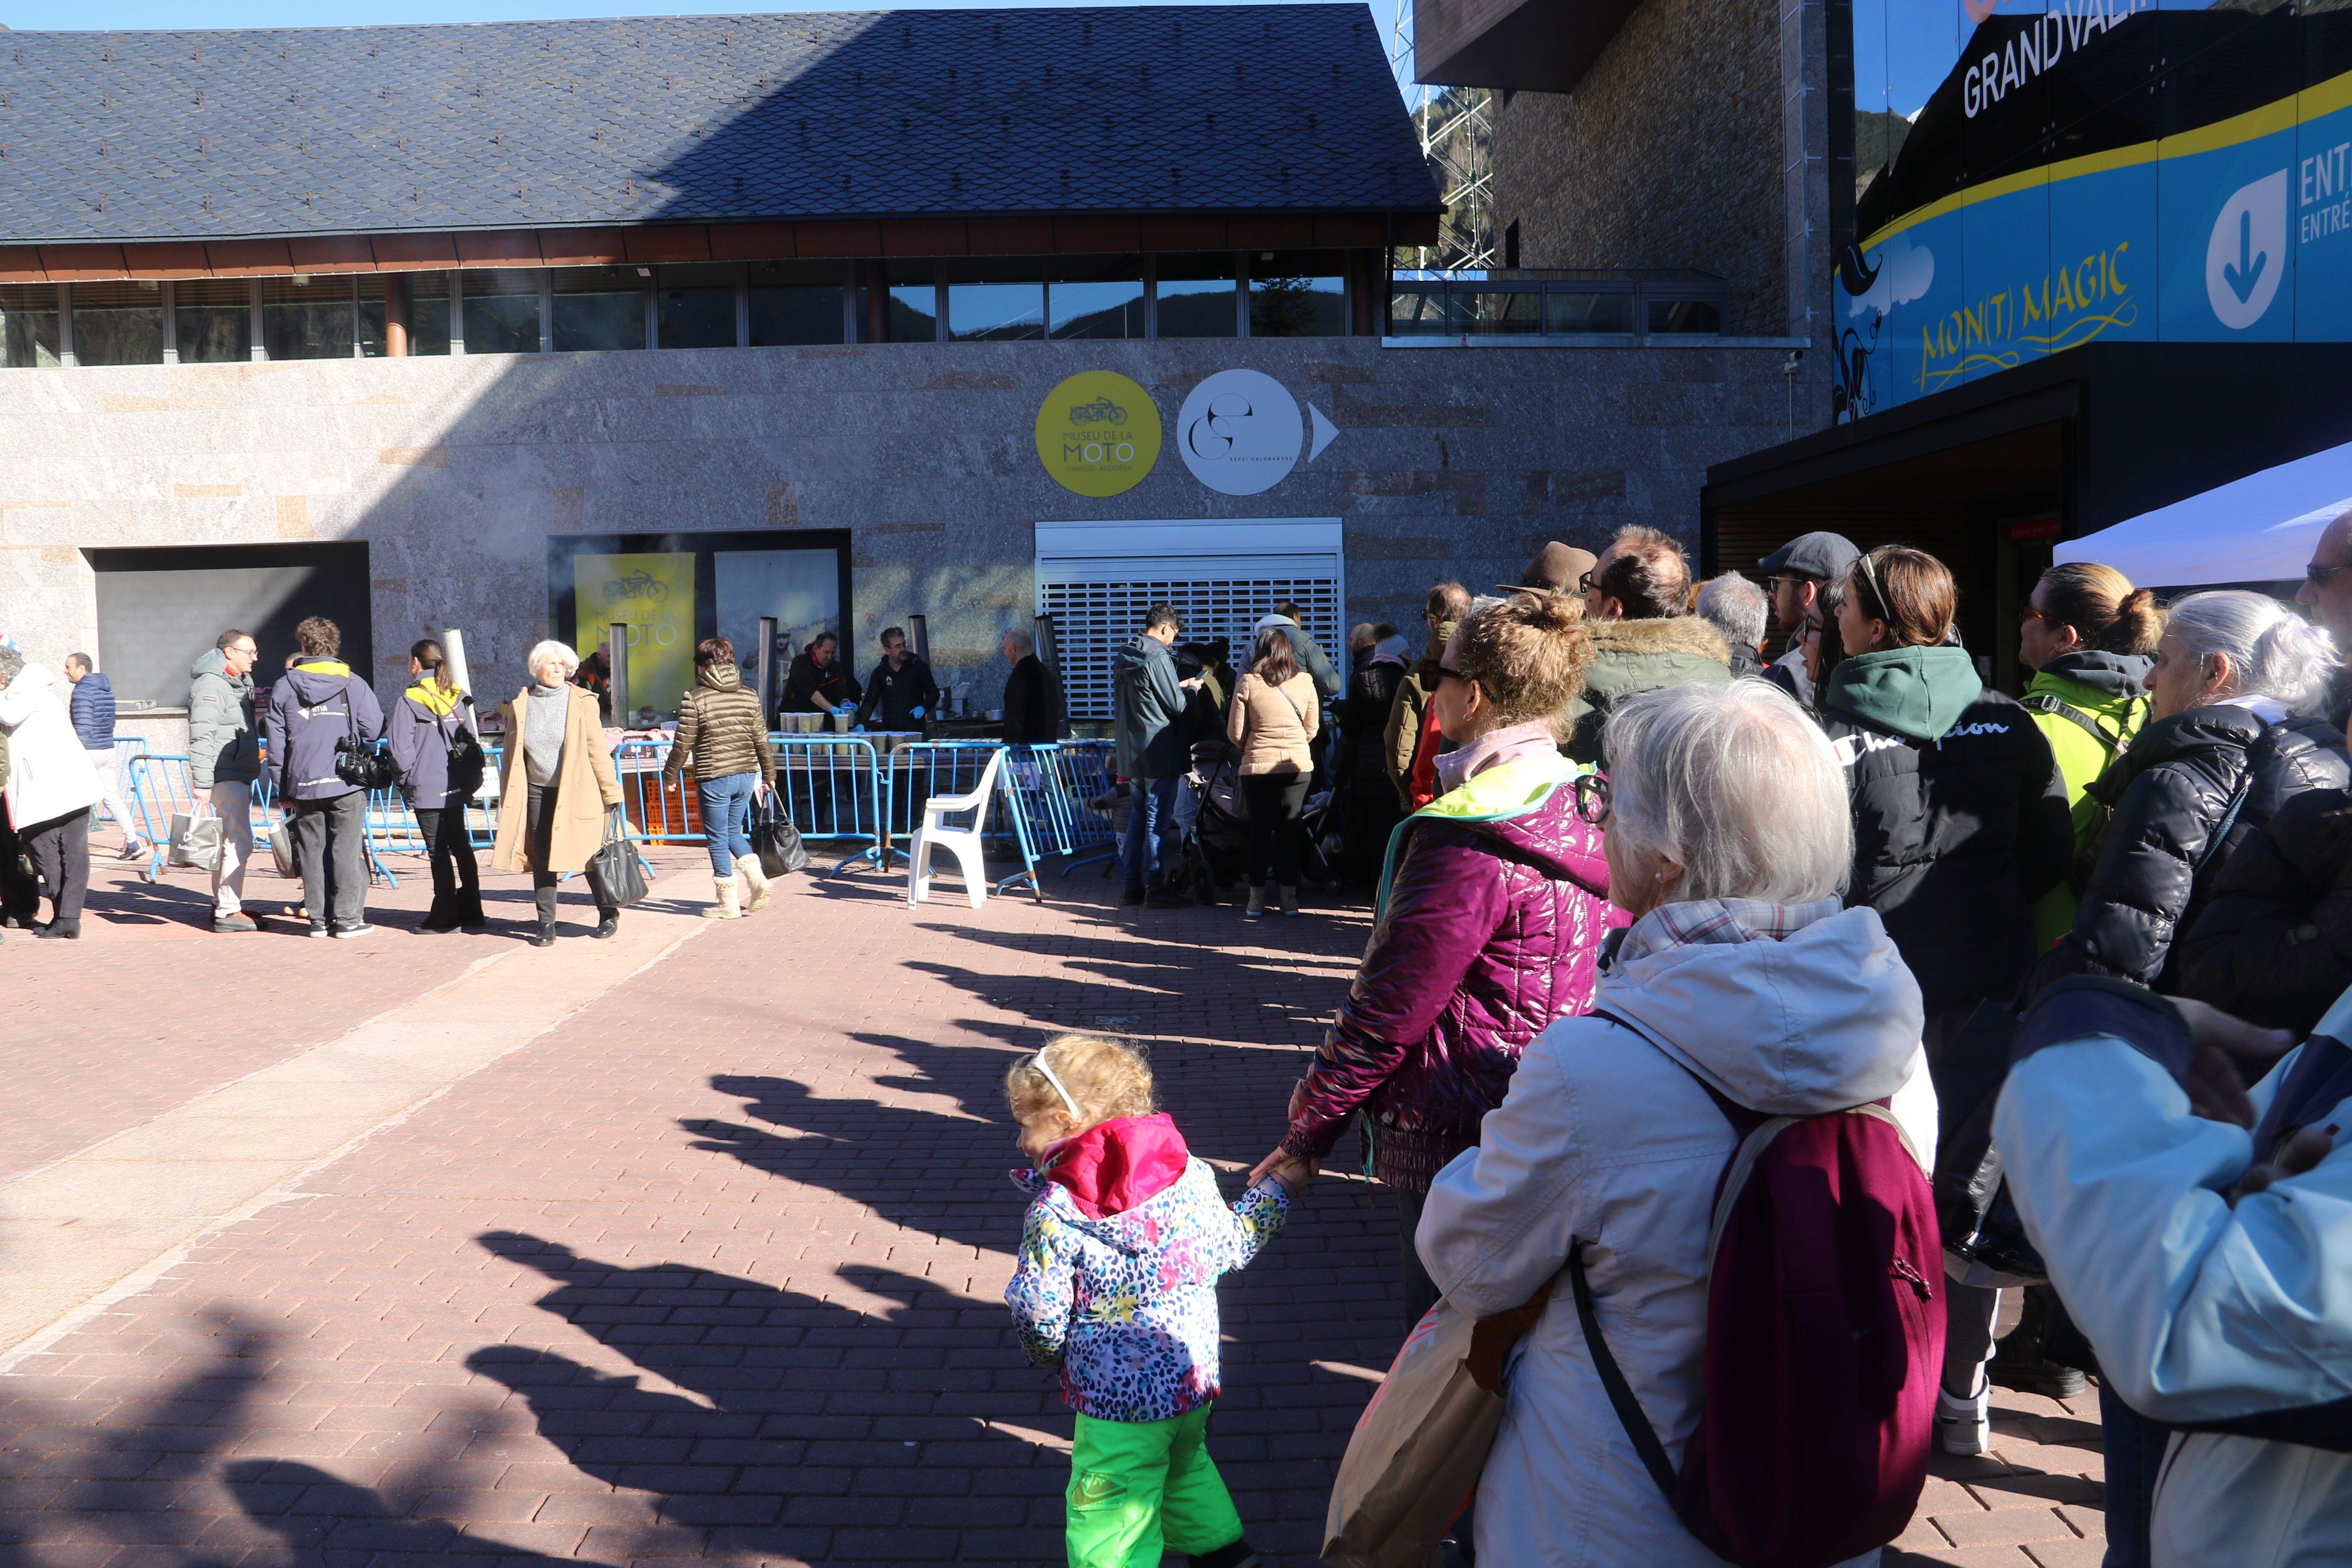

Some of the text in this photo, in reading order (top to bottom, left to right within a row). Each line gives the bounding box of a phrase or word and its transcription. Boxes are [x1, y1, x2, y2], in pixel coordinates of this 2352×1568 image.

[1964, 0, 2147, 119] GRANDVAL
[2301, 141, 2352, 207] ENT
[2301, 191, 2352, 244] ENTRÉ
[2023, 242, 2129, 330] MAGIC
[1063, 431, 1133, 441] MUSEU DE LA
[1063, 443, 1135, 462] MOTO
[595, 609, 675, 621] MUSEU DE LA
[1830, 721, 2009, 766] Chapion
